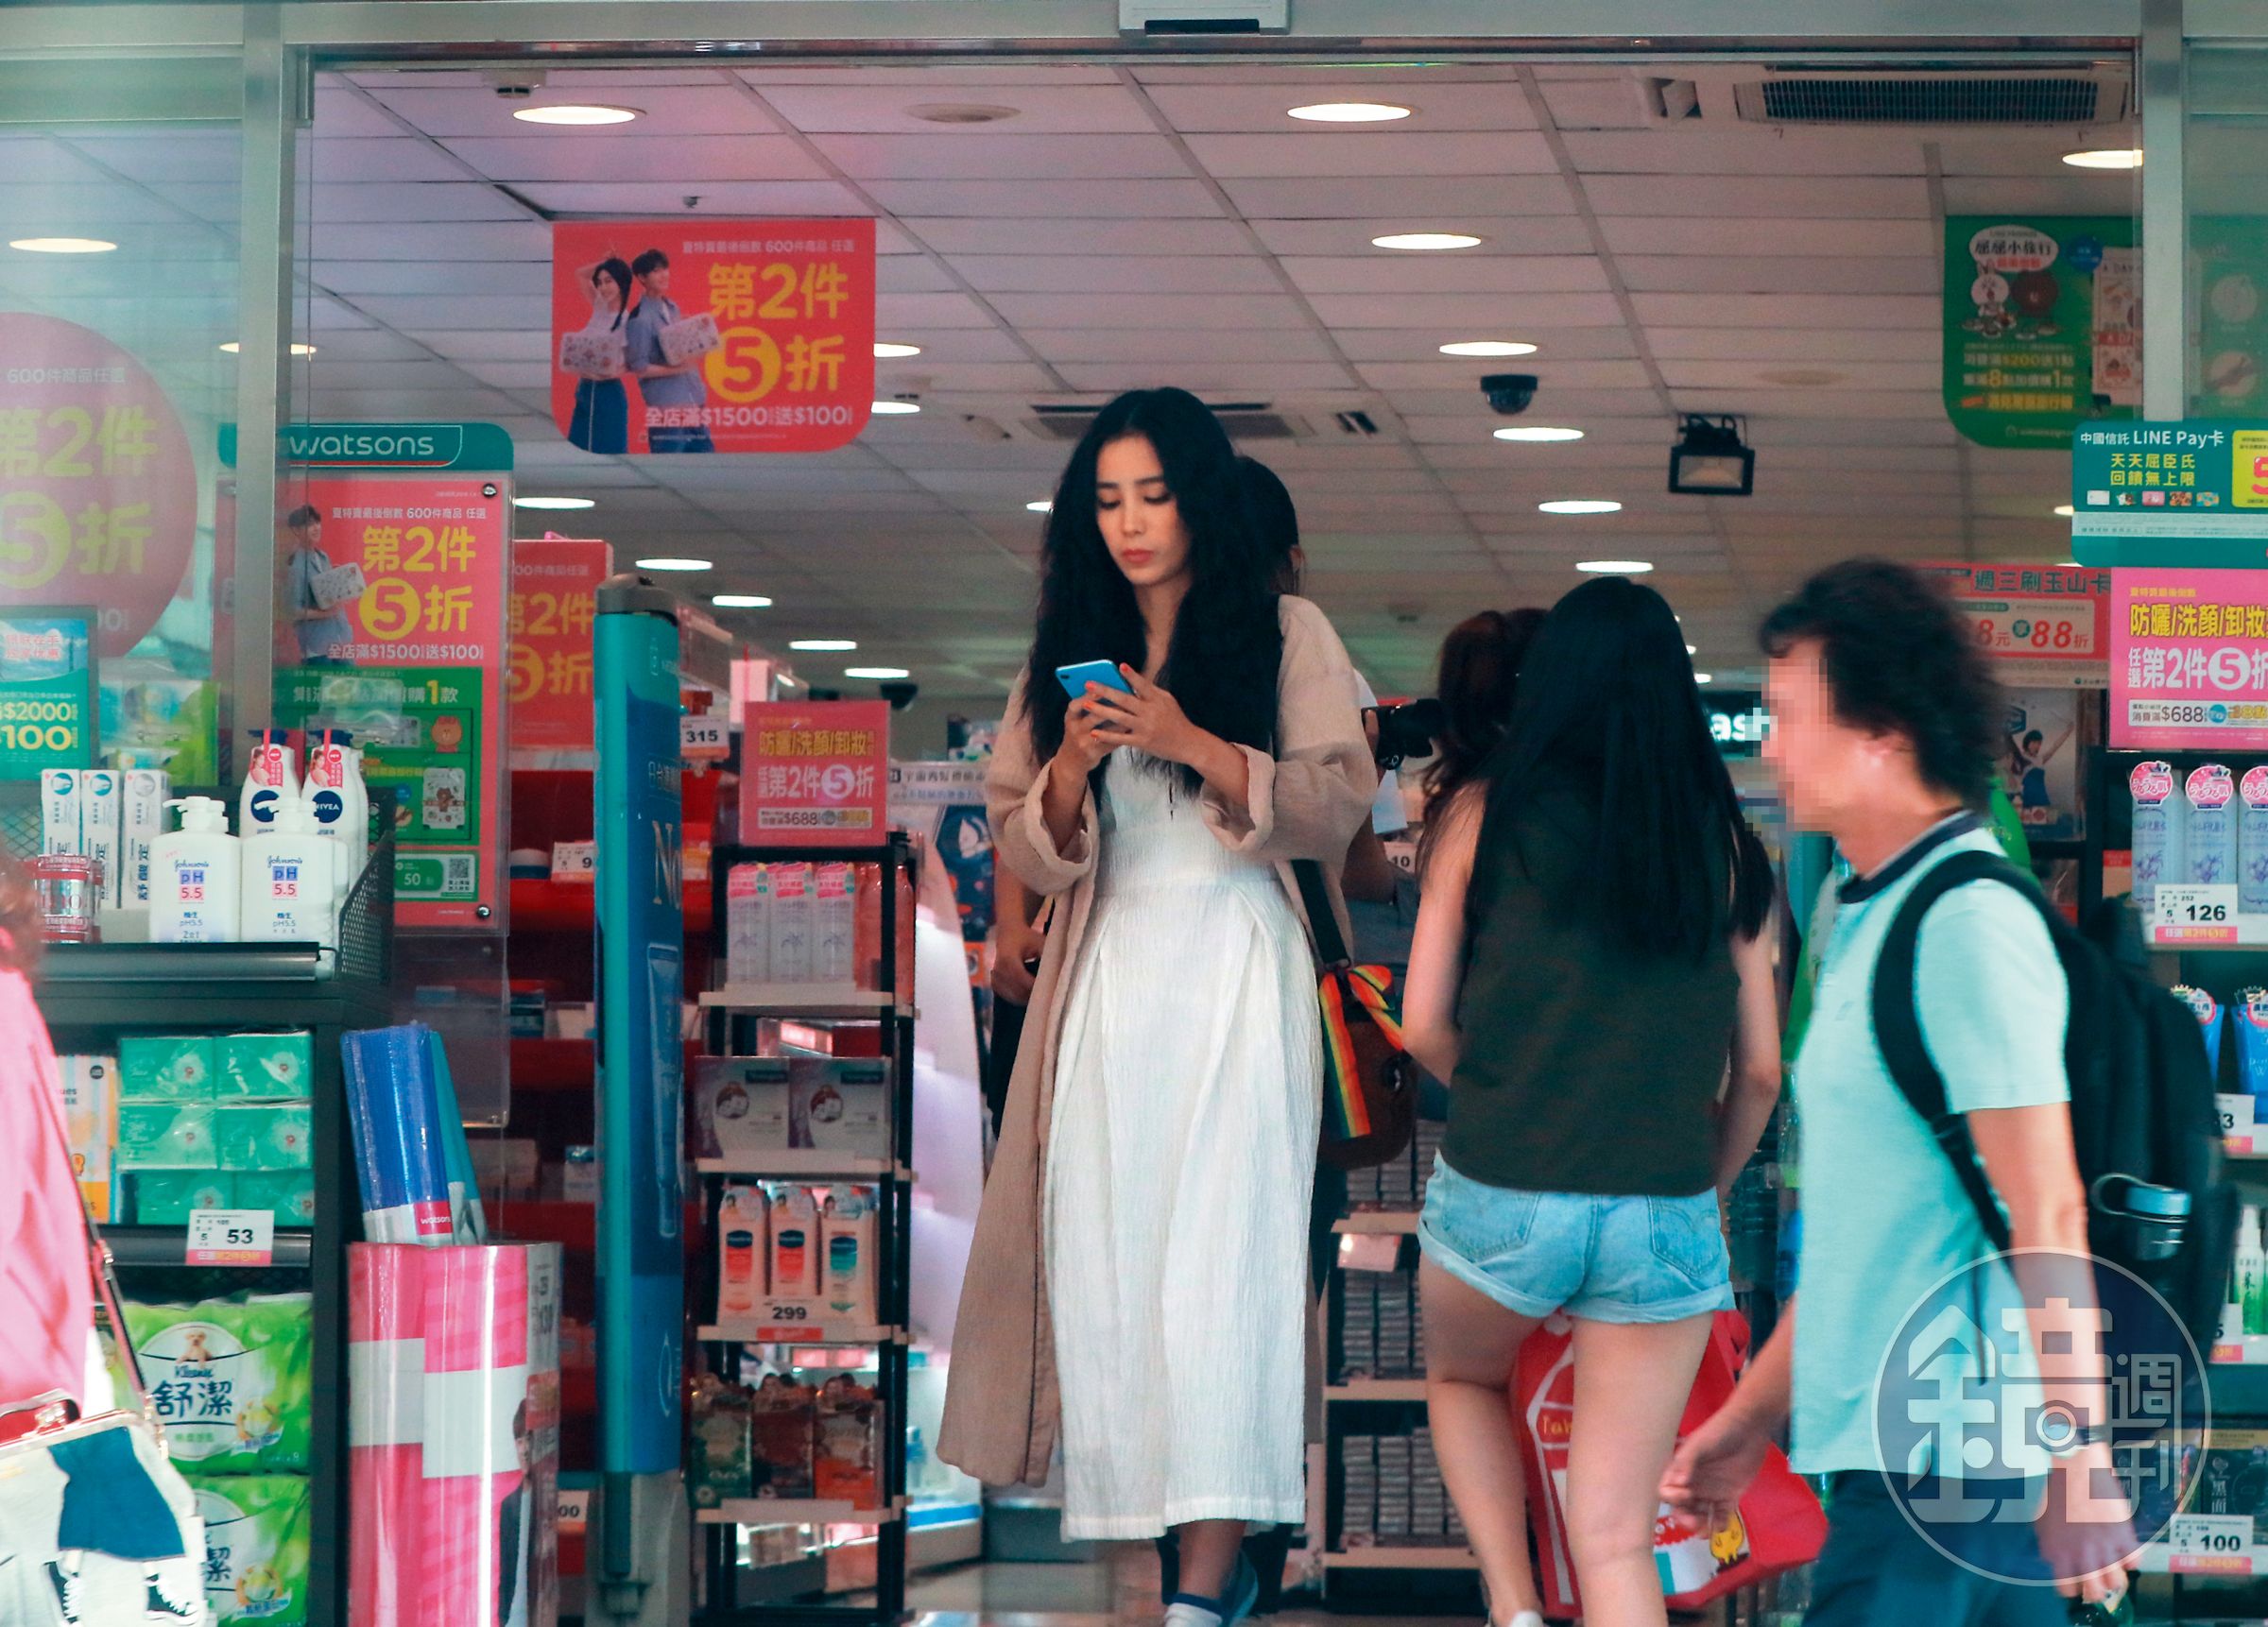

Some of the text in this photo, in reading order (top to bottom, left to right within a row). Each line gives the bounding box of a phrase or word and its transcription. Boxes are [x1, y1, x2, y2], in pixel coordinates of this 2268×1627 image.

[708, 263, 850, 320] 第2件
[704, 326, 847, 403] 5折
[0, 404, 159, 478] 第2件
[289, 434, 435, 455] watsons
[2080, 432, 2130, 446] 中國信託
[2133, 431, 2173, 445] LINE
[2110, 453, 2196, 469] 天天屈臣氏
[2110, 471, 2195, 487] 回饋無上限
[363, 524, 476, 573] 第2件
[358, 577, 473, 641] 5折
[2030, 620, 2089, 648] 88折
[0, 701, 72, 722] $2000
[0, 725, 73, 751] 100
[686, 729, 718, 743] 315
[180, 871, 204, 884] pH
[275, 867, 299, 881] pH
[180, 887, 203, 899] 5.5
[274, 883, 296, 896] 5.5
[2186, 904, 2226, 921] 126
[273, 919, 297, 928] pH5.5
[227, 1228, 253, 1244] 53
[772, 1307, 807, 1320] 299
[151, 1379, 233, 1419] 舒潔
[2200, 1534, 2241, 1551] 100
[199, 1547, 232, 1583] 潔
